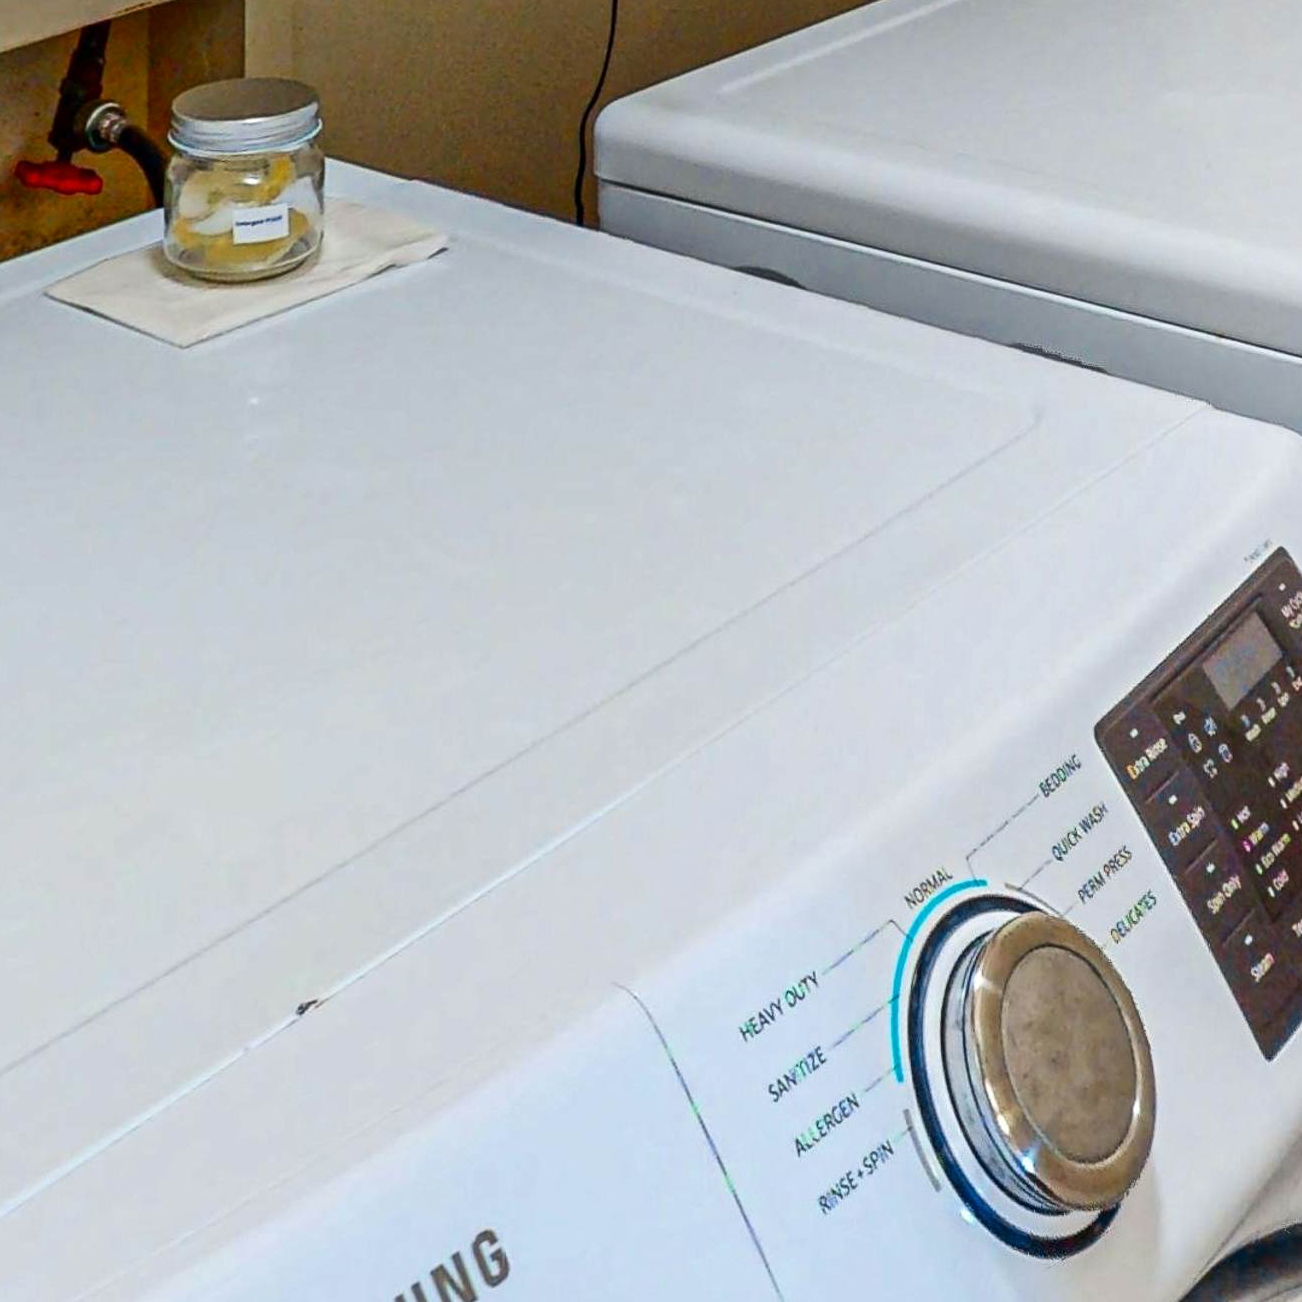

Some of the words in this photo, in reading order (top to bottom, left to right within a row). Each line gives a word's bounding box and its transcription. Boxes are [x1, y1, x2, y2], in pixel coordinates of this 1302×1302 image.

[1038, 754, 1083, 798] BEDDING
[1051, 827, 1083, 862] QUICK
[1078, 801, 1110, 835] WASH
[903, 866, 954, 909] NORMAL
[1077, 869, 1108, 904] PERM
[1102, 844, 1133, 880] PRESS
[1109, 889, 1158, 945] DELICATES
[738, 998, 784, 1043] HEAVY
[768, 1046, 828, 1103] SANITIZE
[794, 1092, 861, 1158] ALLERGEN
[818, 1171, 858, 1215] RINSE
